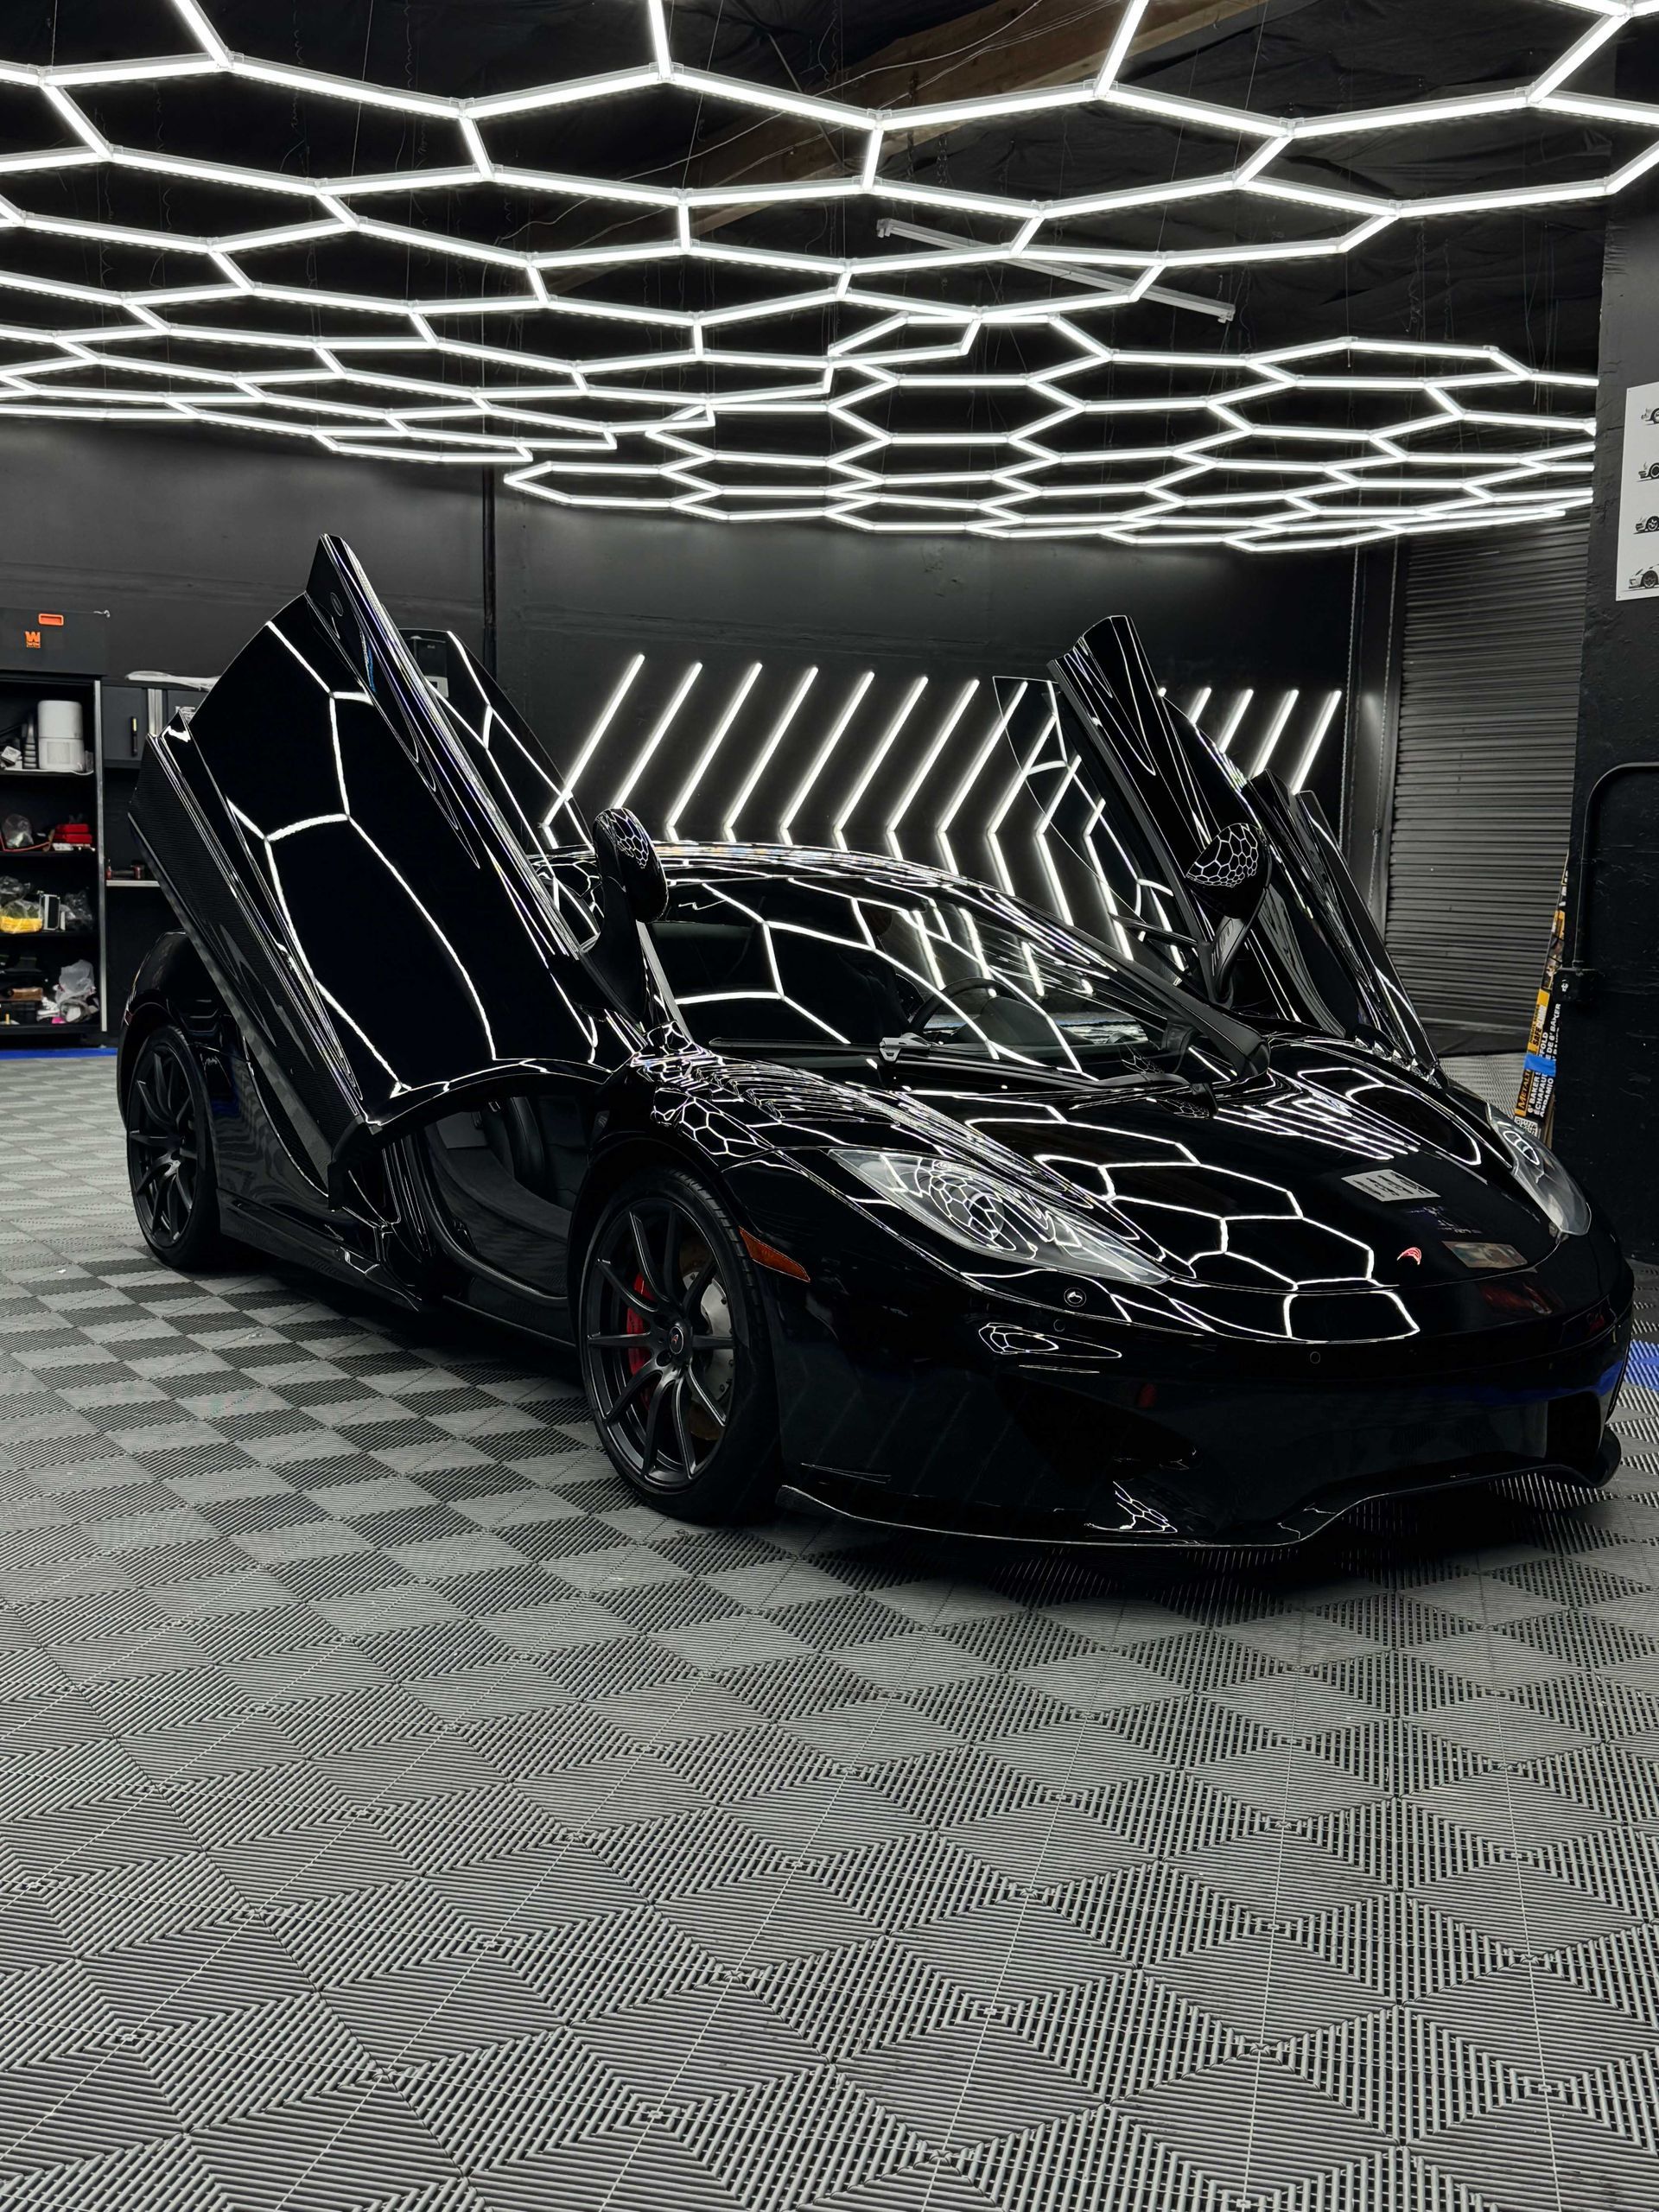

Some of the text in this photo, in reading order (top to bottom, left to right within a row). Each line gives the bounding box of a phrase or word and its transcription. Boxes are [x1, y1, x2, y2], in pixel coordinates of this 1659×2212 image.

[1550, 1003, 1561, 1032] BAKER
[1547, 1042, 1554, 1054] DE
[1529, 1077, 1540, 1104] BAKER
